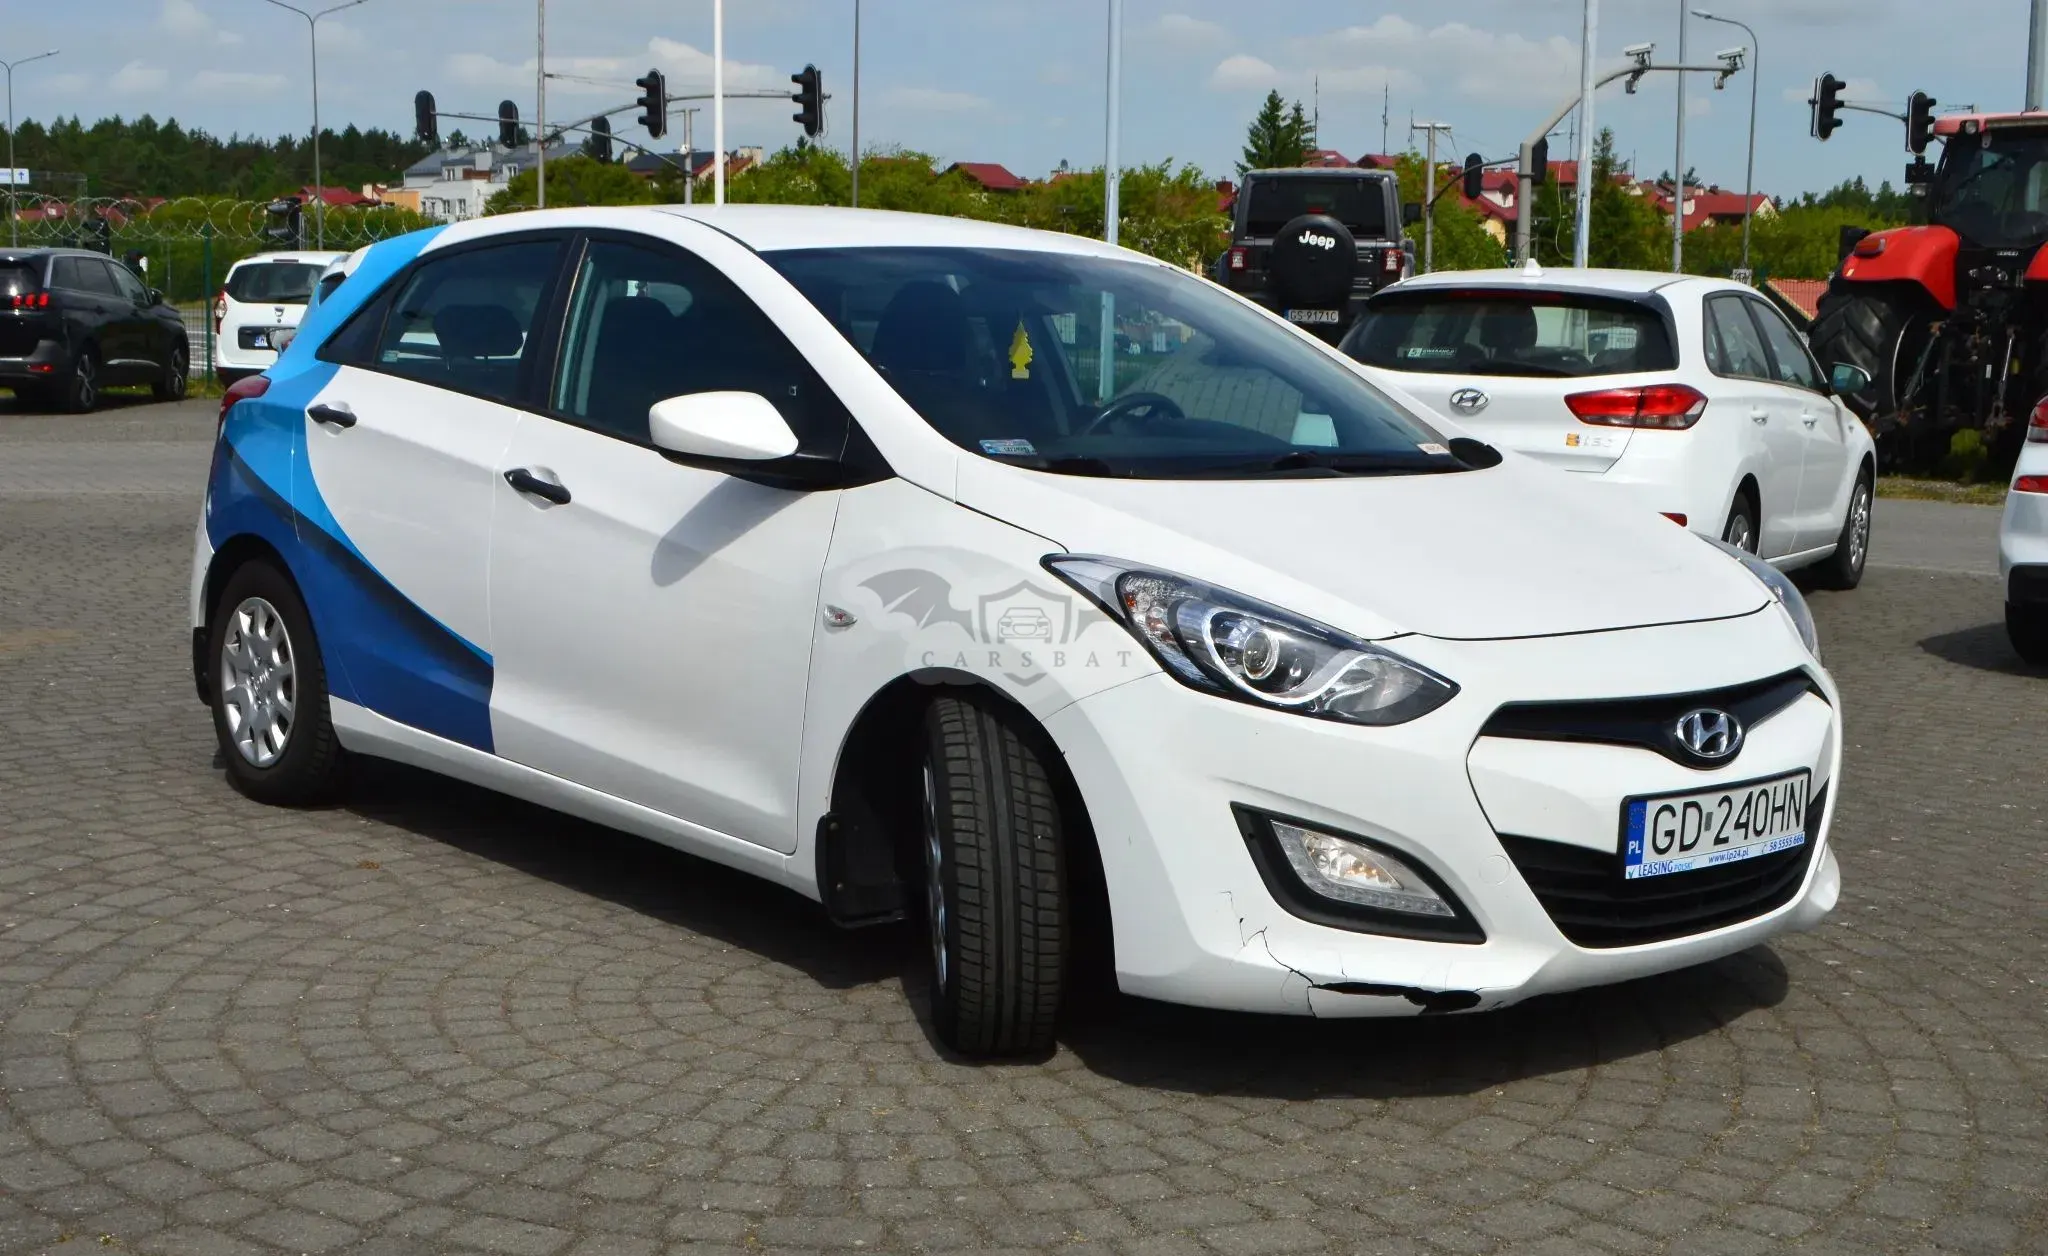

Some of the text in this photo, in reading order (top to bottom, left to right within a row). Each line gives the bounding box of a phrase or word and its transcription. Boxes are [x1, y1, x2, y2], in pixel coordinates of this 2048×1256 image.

[1299, 230, 1335, 250] Jeep
[1651, 780, 1804, 856] GD 240HN
[1628, 840, 1642, 855] PL
[1639, 861, 1673, 876] LEASING
